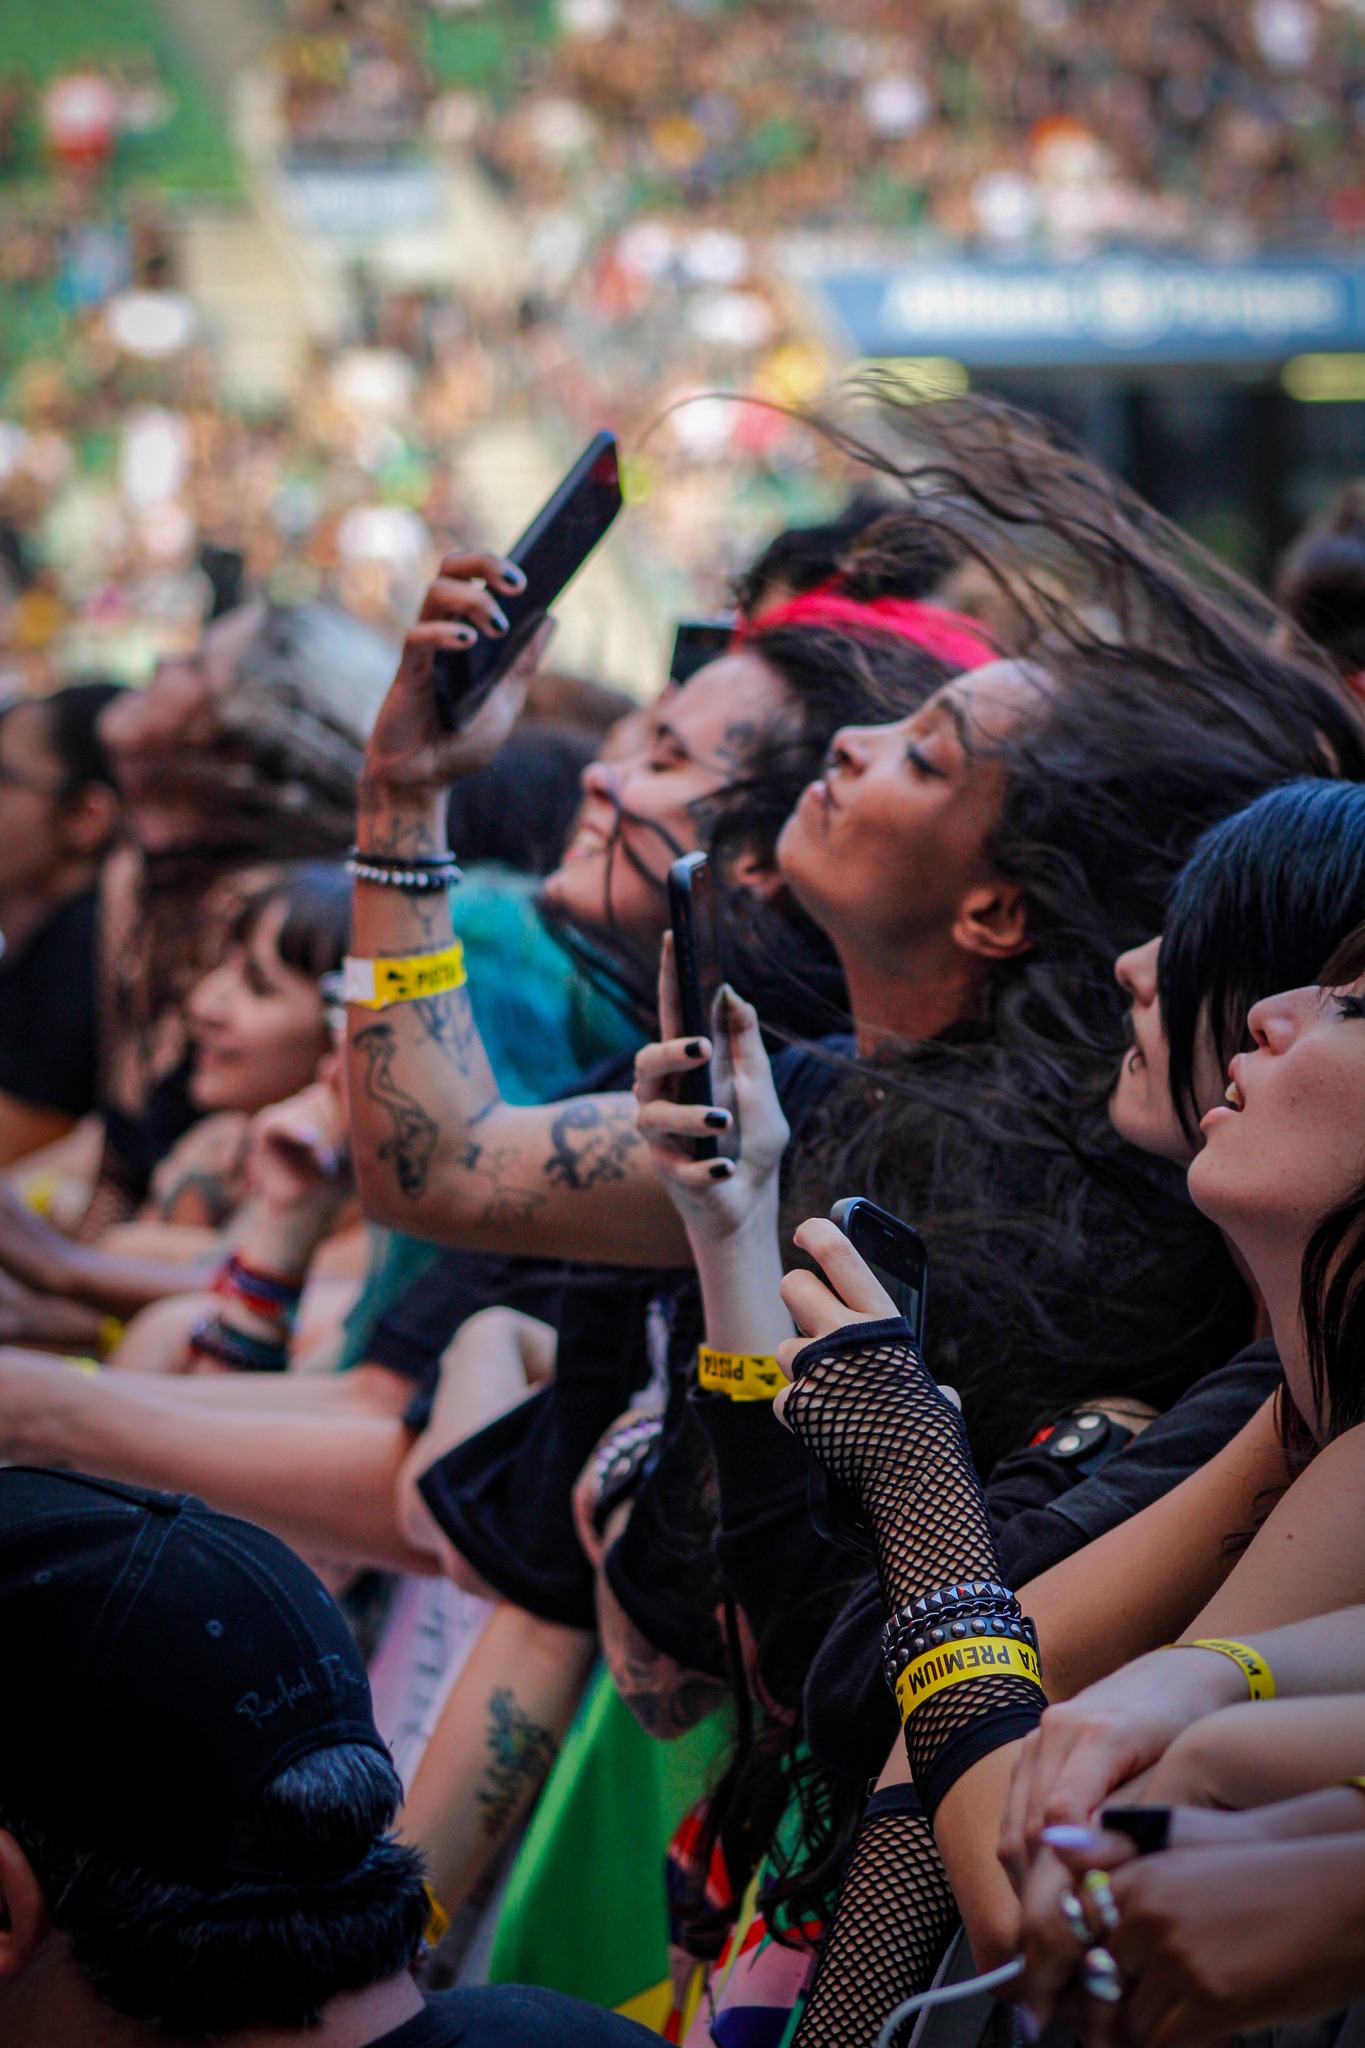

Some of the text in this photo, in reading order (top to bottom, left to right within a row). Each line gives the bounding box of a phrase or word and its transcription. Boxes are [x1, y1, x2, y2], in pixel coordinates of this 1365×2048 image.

[704, 1354, 744, 1380] PISTA
[908, 1644, 1039, 1696] TA PREMIUM
